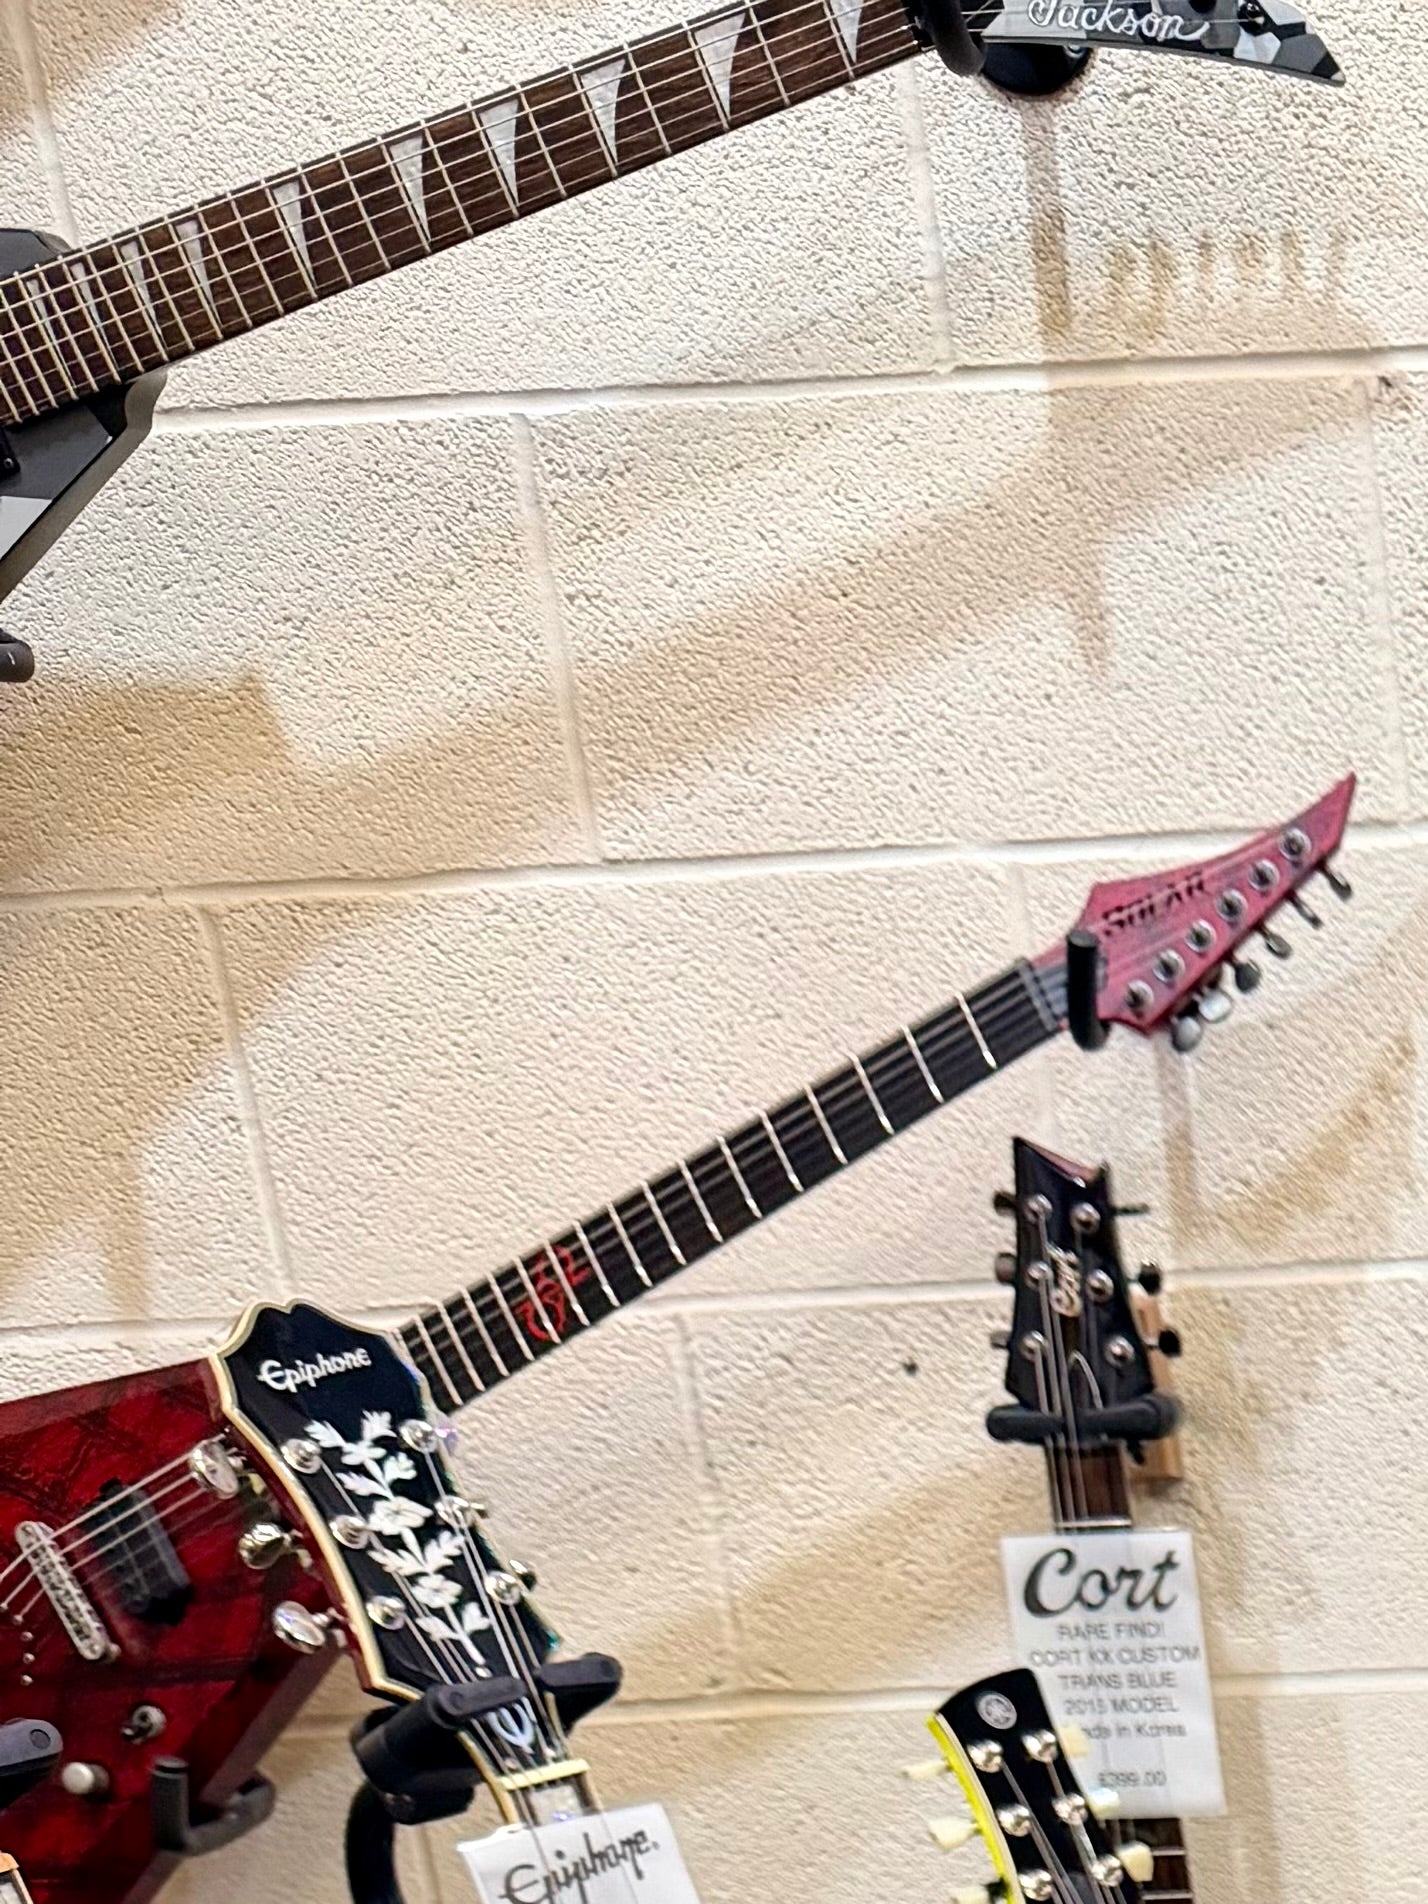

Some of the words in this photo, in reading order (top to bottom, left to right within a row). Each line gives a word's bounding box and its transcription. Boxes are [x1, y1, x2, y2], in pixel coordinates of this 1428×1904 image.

[1027, 0, 1211, 42] Jackson
[256, 1347, 371, 1393] Epiphone
[1023, 1548, 1181, 1618] Cort
[1057, 1623, 1110, 1641] RARE
[1030, 1651, 1081, 1667] CORT
[1115, 1647, 1200, 1665] CUSTOM
[1057, 1674, 1122, 1690] TRANS
[1127, 1673, 1177, 1689] BLUE
[1111, 1698, 1180, 1714] MODEL
